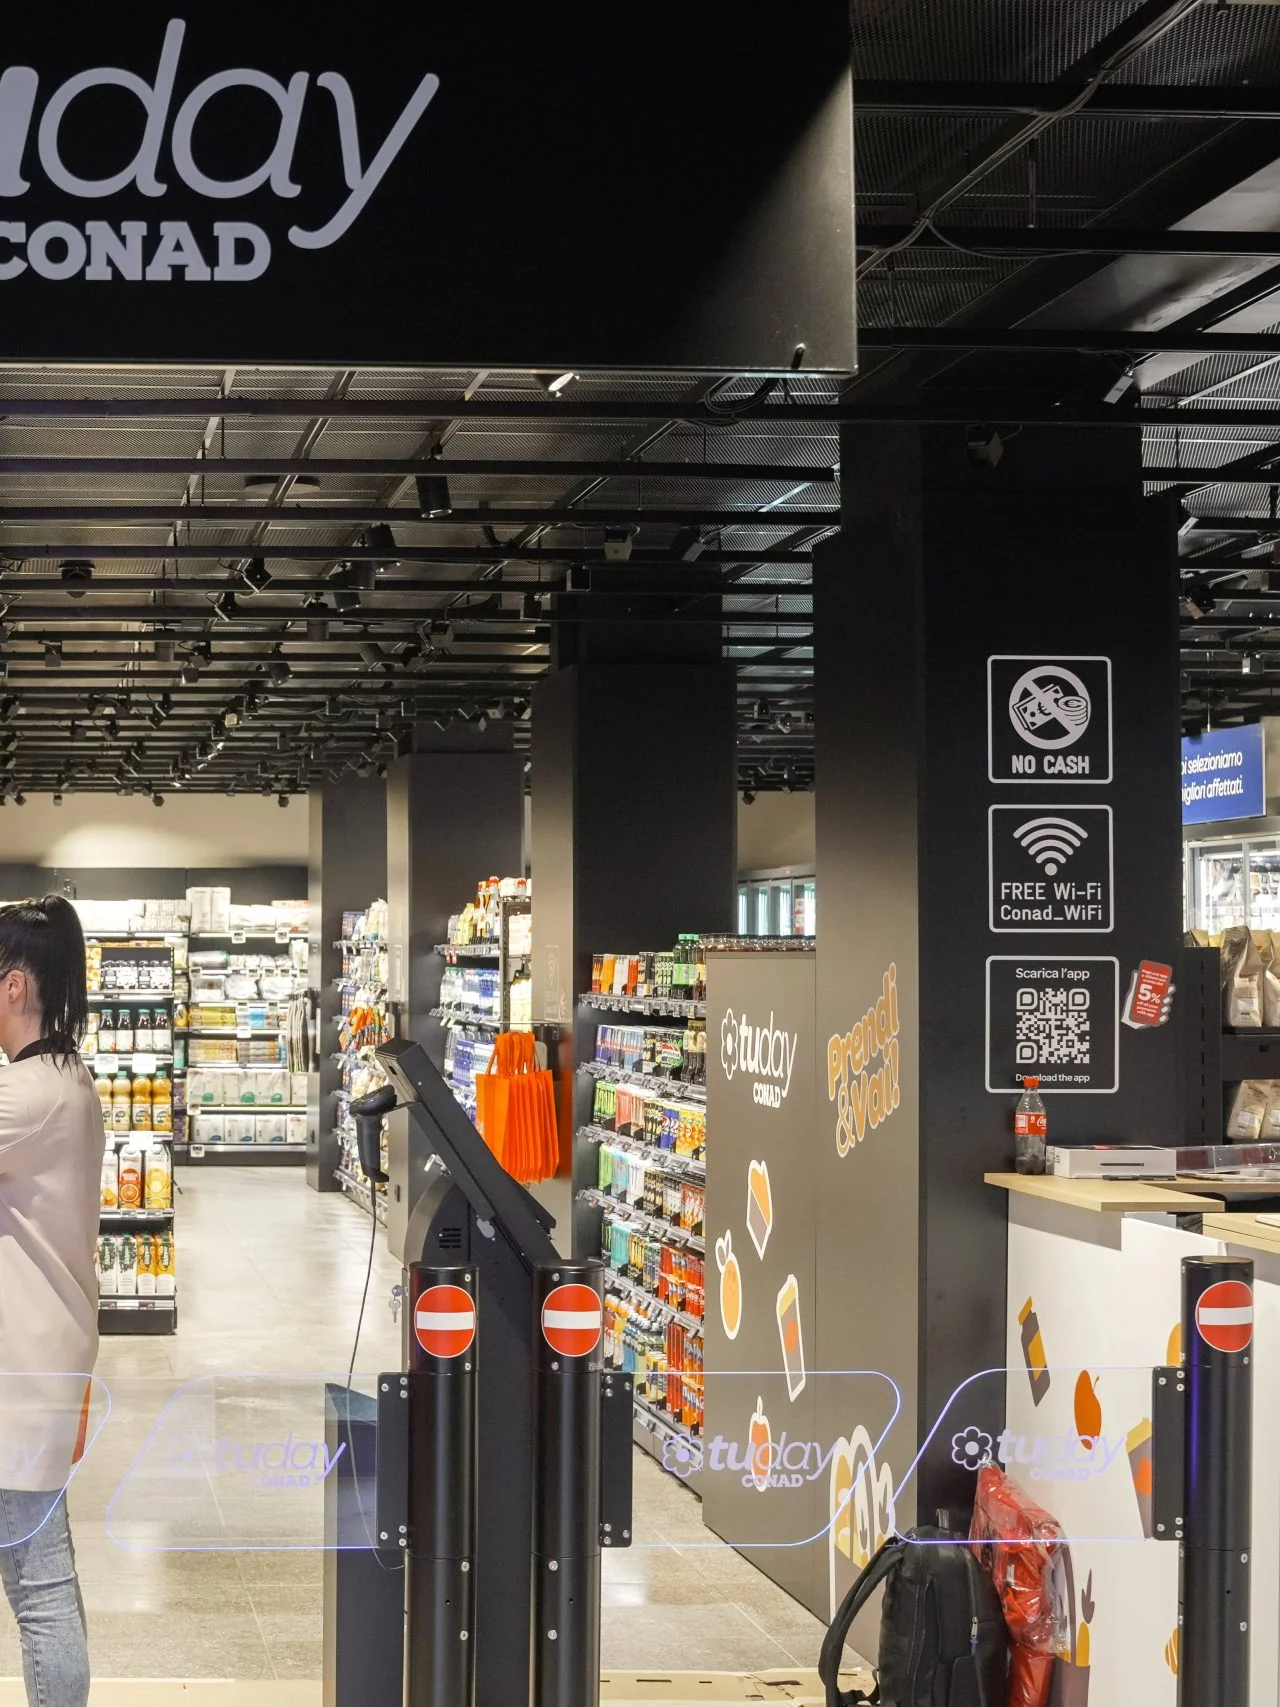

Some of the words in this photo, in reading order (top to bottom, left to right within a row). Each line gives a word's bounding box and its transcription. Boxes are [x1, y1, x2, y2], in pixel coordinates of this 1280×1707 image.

[1011, 755, 1036, 774] NO
[1043, 755, 1090, 774] CASH
[1188, 749, 1243, 774] selezioniamo
[1206, 774, 1244, 798] affettati.
[1001, 882, 1046, 900] FREE
[1053, 882, 1102, 900] Wi-Fi
[1000, 904, 1102, 921] Conad_WiFi
[1015, 967, 1059, 979] Scarica
[1138, 983, 1161, 1004] 5%
[828, 962, 899, 1101] Prendi
[739, 1010, 797, 1098] tuday
[1058, 1073, 1073, 1081] the
[1073, 1075, 1090, 1083] app
[753, 1081, 781, 1109] CONAD
[215, 1431, 347, 1481] tuday
[708, 1431, 838, 1481] tuday
[996, 1425, 1125, 1474] tuday
[741, 1473, 803, 1488] CONAD
